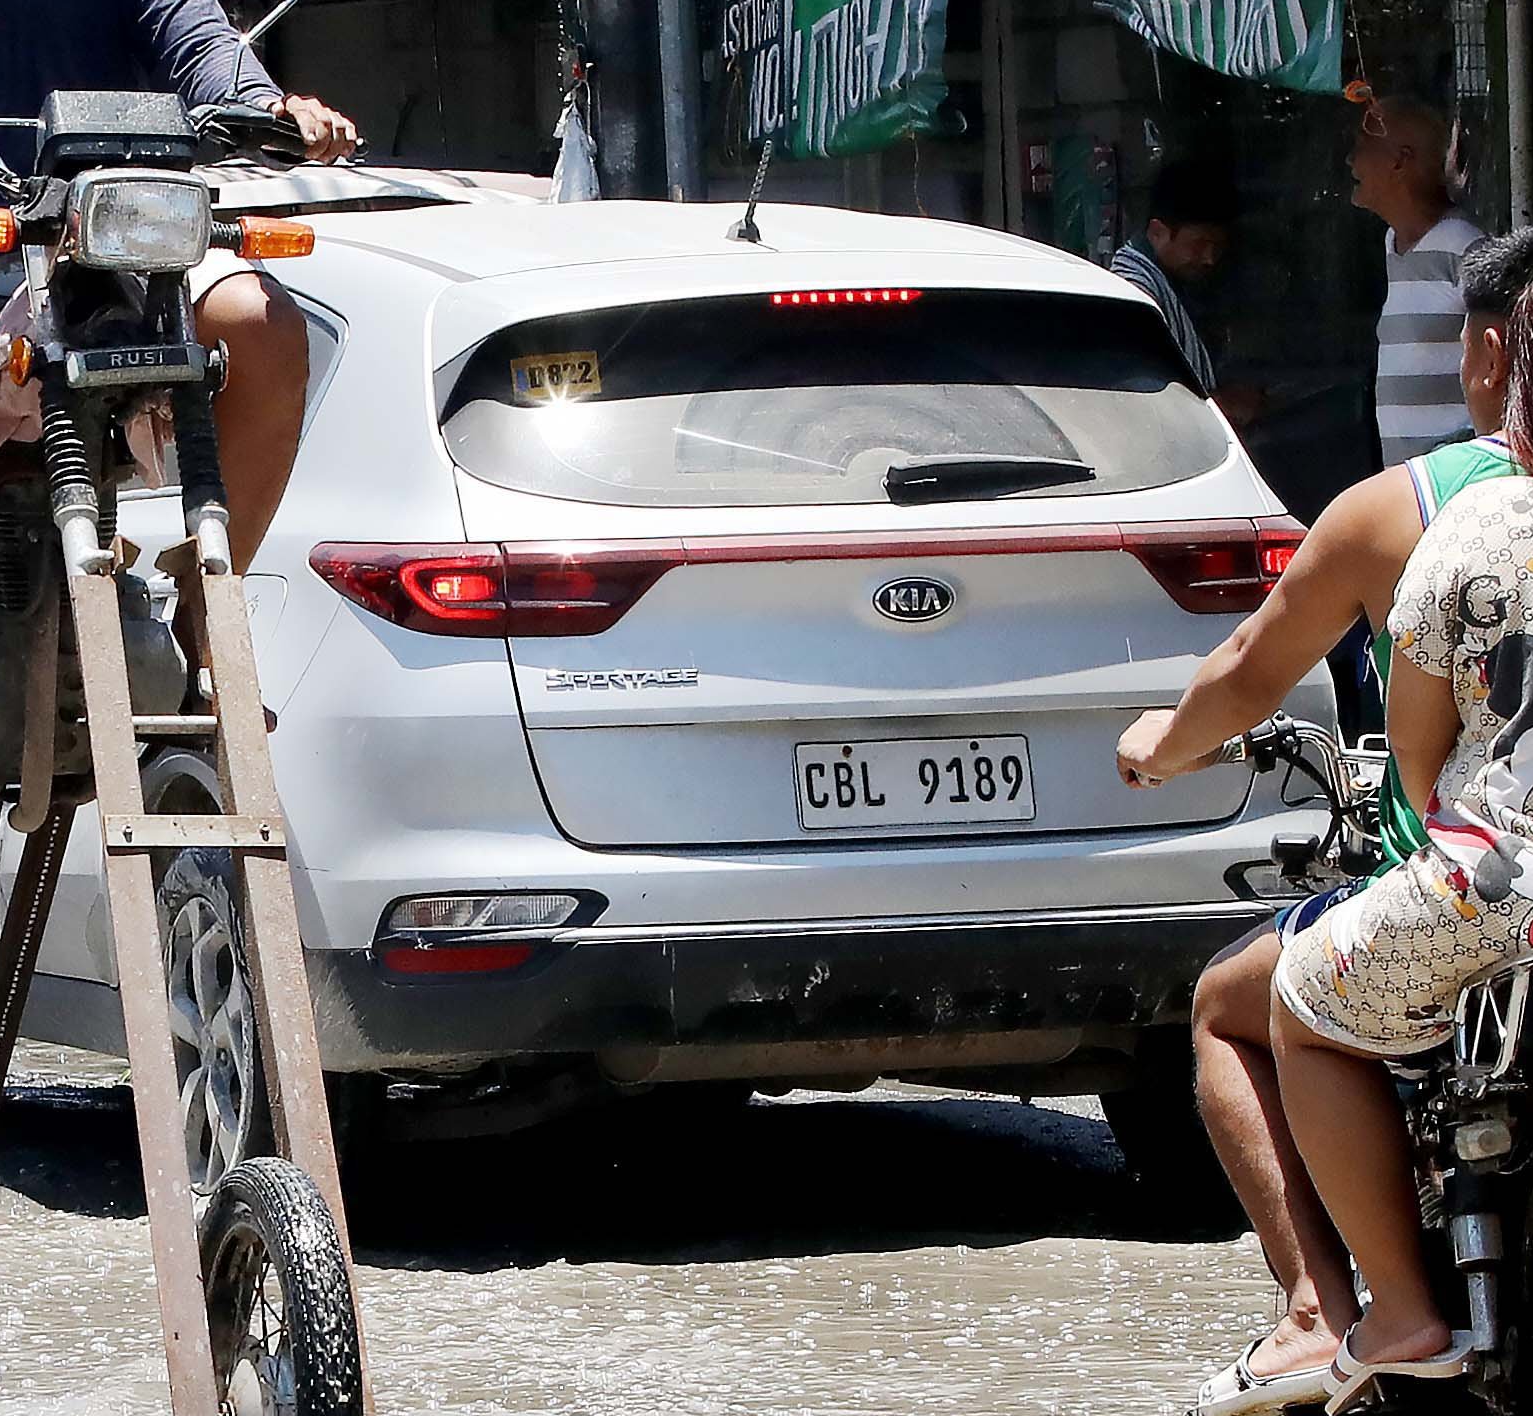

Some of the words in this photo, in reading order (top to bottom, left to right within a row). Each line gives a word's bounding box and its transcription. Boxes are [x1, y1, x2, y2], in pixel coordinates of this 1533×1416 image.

[110, 351, 164, 368] RUSI
[888, 586, 942, 613] KIA
[546, 667, 699, 691] SPORTAGE
[805, 761, 886, 809] CBL
[918, 755, 1024, 805] 9189
